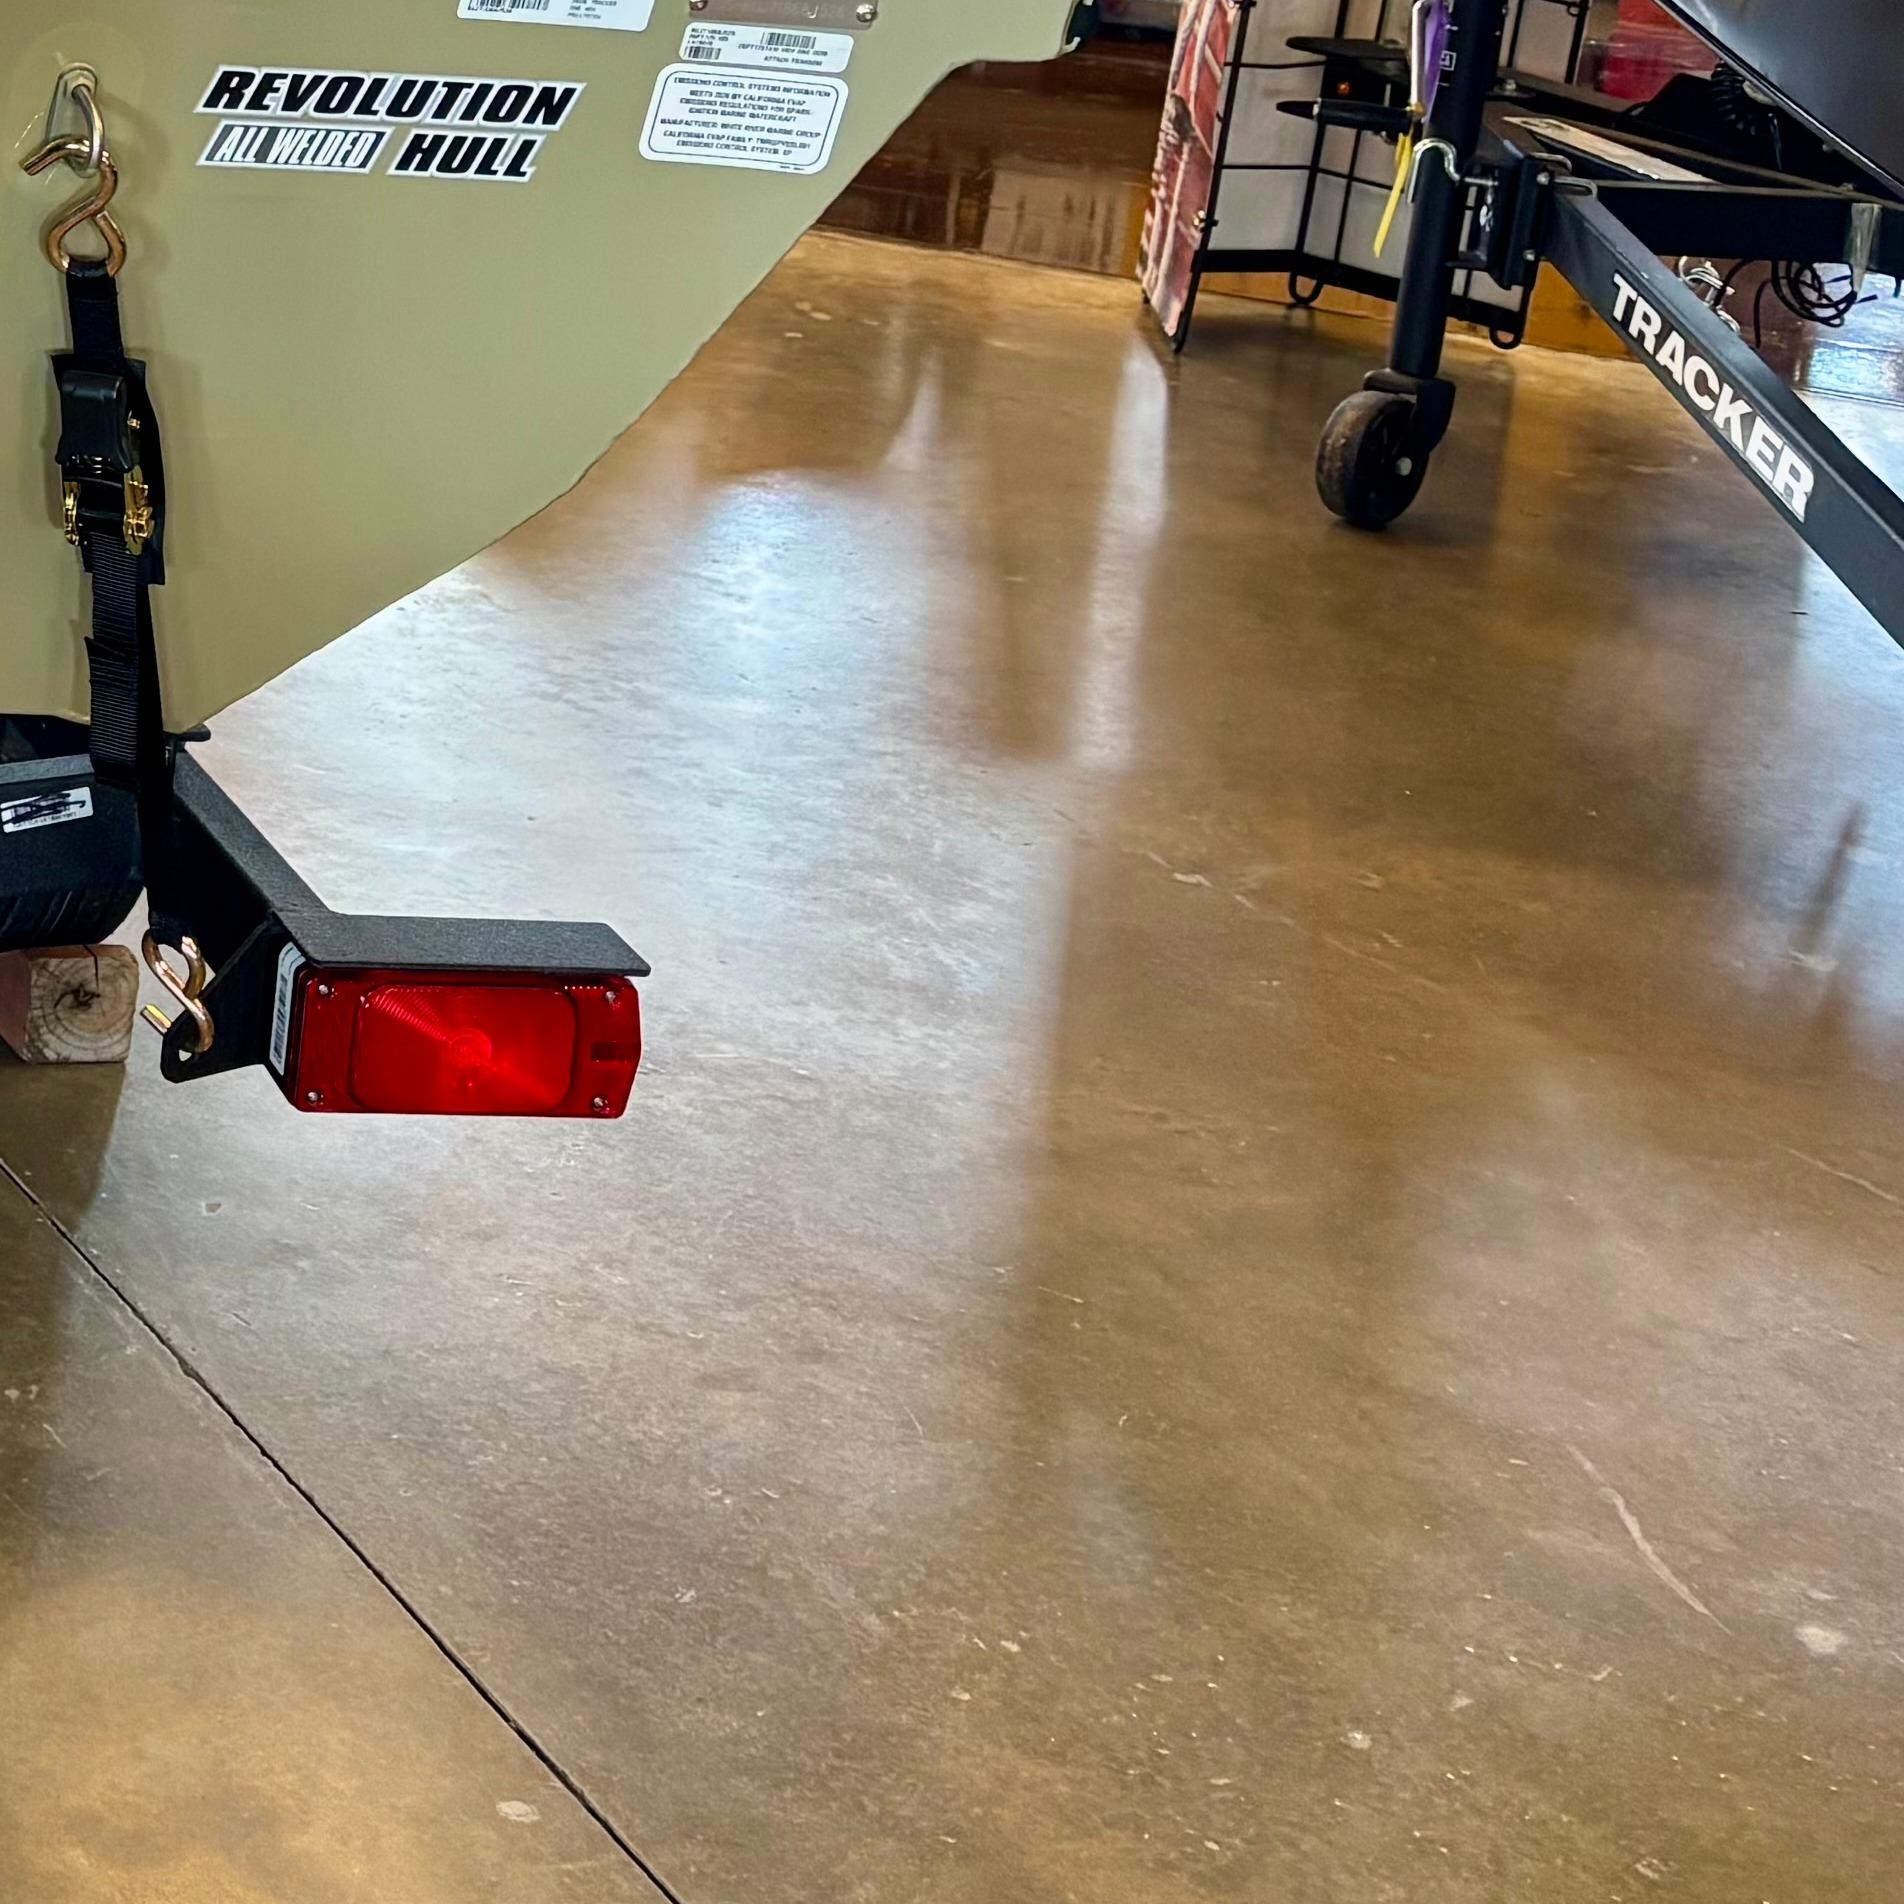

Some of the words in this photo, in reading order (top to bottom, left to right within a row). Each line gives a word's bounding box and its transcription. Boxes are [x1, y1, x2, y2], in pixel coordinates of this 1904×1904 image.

[201, 69, 578, 127] REVOLUTION
[213, 127, 260, 162] ALL
[266, 128, 378, 168] WELDED
[394, 133, 538, 178] HULL
[1612, 273, 1815, 524] TRACKER
